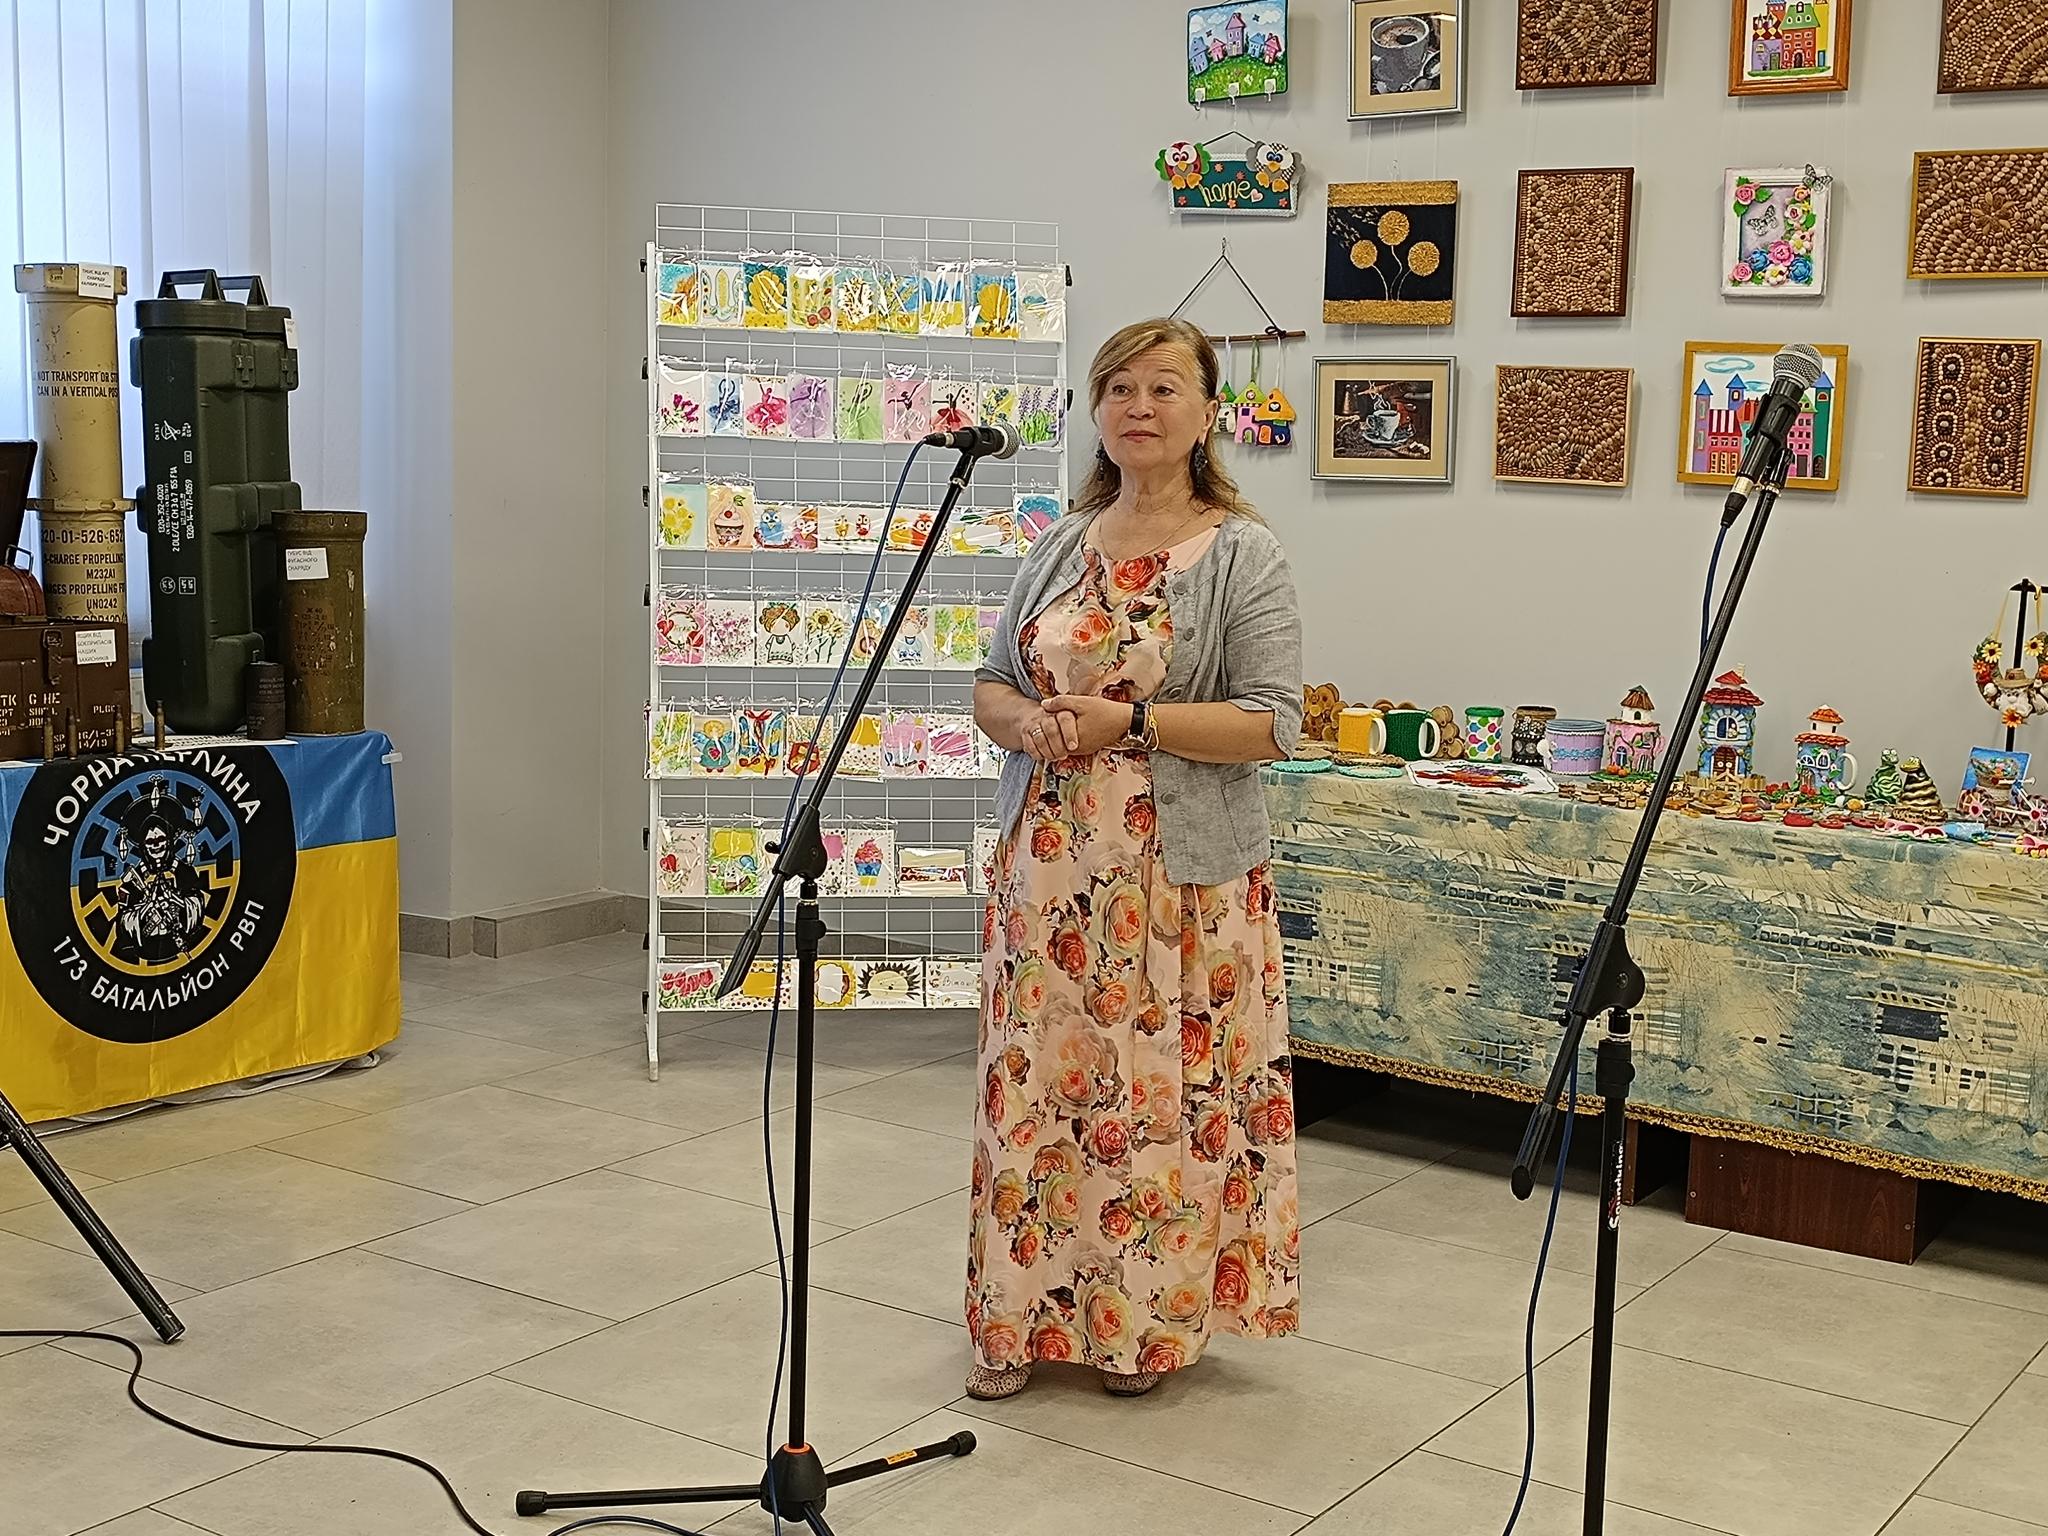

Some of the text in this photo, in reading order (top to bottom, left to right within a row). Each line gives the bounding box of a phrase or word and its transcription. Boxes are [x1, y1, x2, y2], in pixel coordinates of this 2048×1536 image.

[1199, 181, 1251, 207] home
[51, 371, 98, 382] TRANSPORT
[100, 372, 109, 382] OR
[37, 385, 49, 396] CAN
[52, 386, 59, 396] IN
[62, 386, 68, 396] A
[70, 386, 107, 397] VERTICAL
[69, 583, 118, 595] PROPELLING
[53, 900, 265, 1012] 173 БАТАЛЬЙОН РВП
